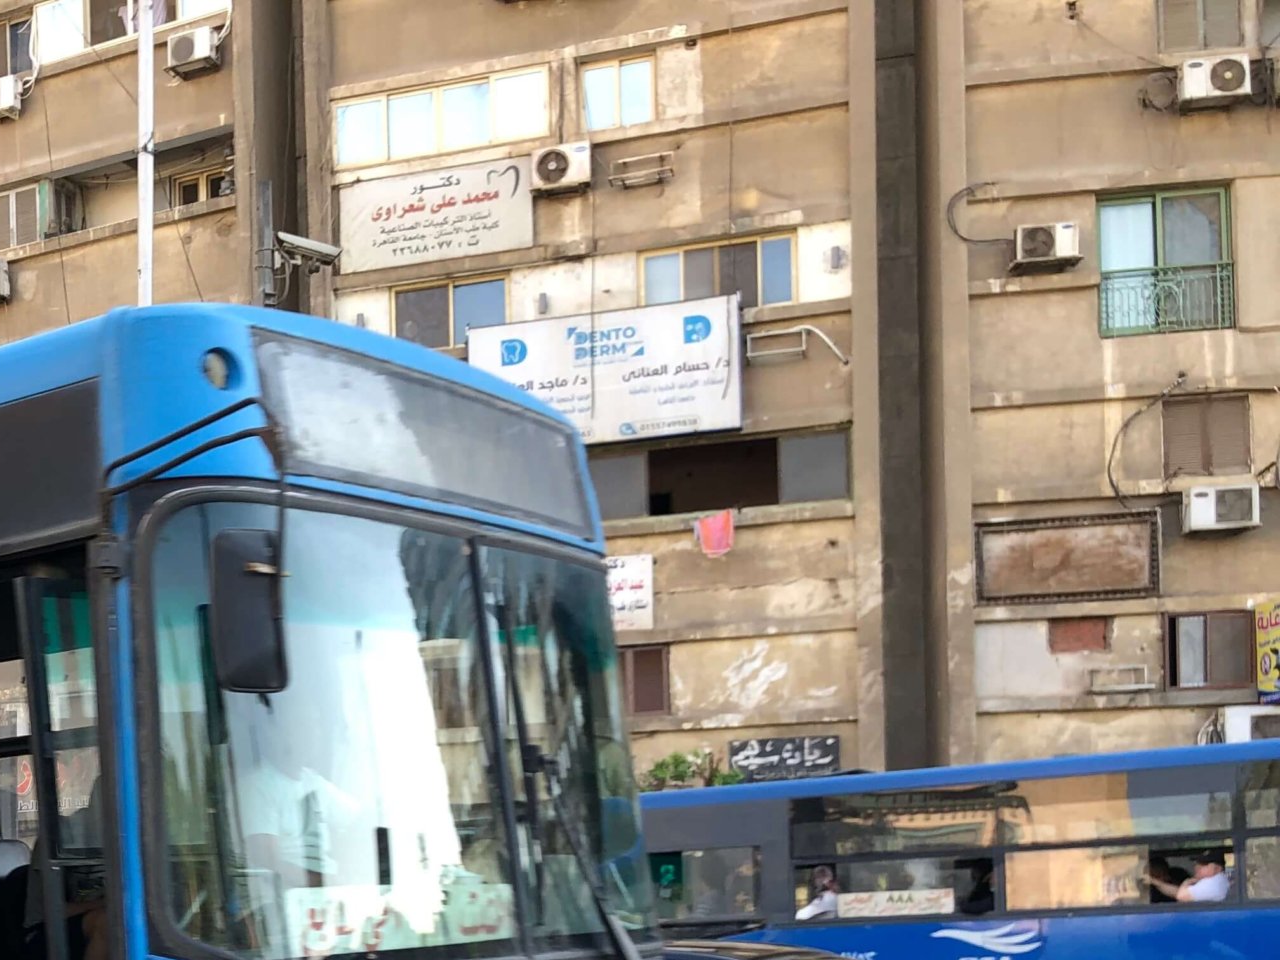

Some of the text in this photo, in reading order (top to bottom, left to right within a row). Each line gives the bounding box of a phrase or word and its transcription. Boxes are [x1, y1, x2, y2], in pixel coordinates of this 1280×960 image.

[371, 190, 500, 222] محمد على شعراوى
[379, 208, 492, 236] أستاذ التركيبات الصناعية
[481, 221, 500, 233] كلية
[372, 235, 401, 249] القاهرة
[402, 232, 427, 243] جامعة
[574, 326, 636, 346] DENTO
[574, 341, 627, 361] DERM
[674, 361, 710, 376] حسام
[537, 376, 568, 393] ماجد
